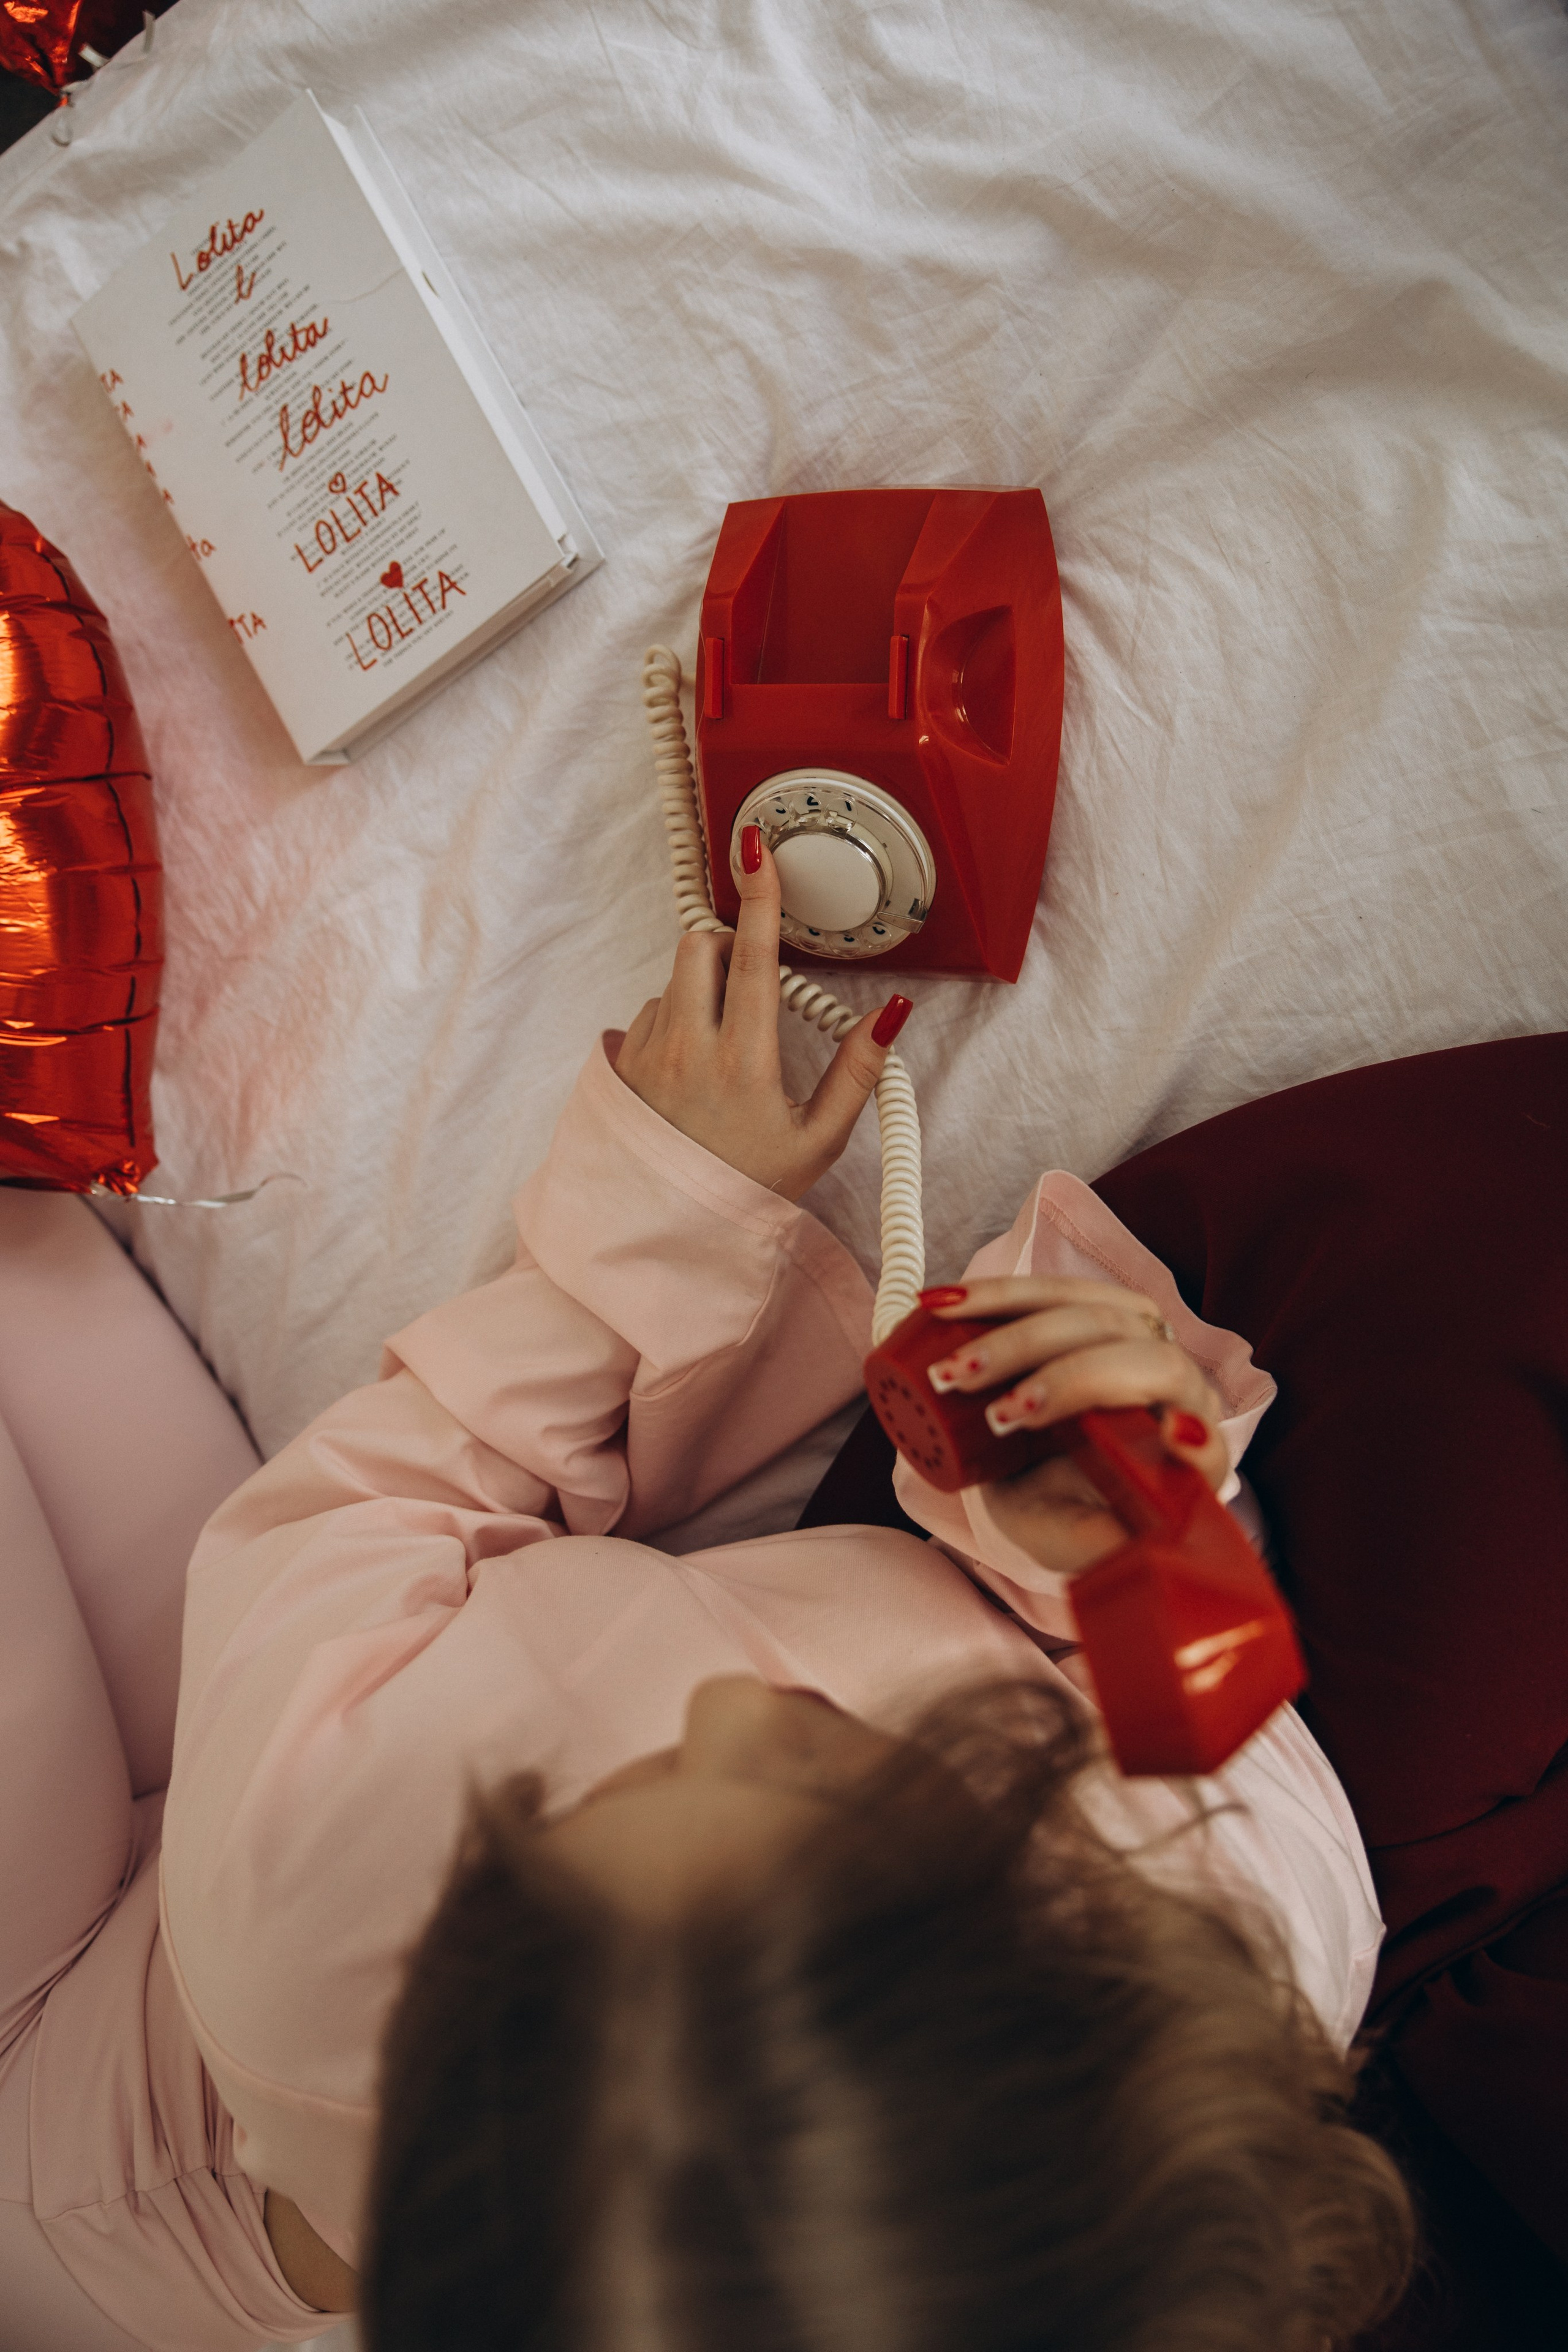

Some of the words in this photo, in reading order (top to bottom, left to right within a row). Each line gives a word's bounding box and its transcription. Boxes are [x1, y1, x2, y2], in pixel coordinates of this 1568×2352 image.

[170, 209, 265, 292] Lolita
[238, 317, 328, 401] lolita
[279, 371, 389, 472] lolita
[294, 472, 399, 573] LOLITA
[347, 570, 467, 671] LOLITA
